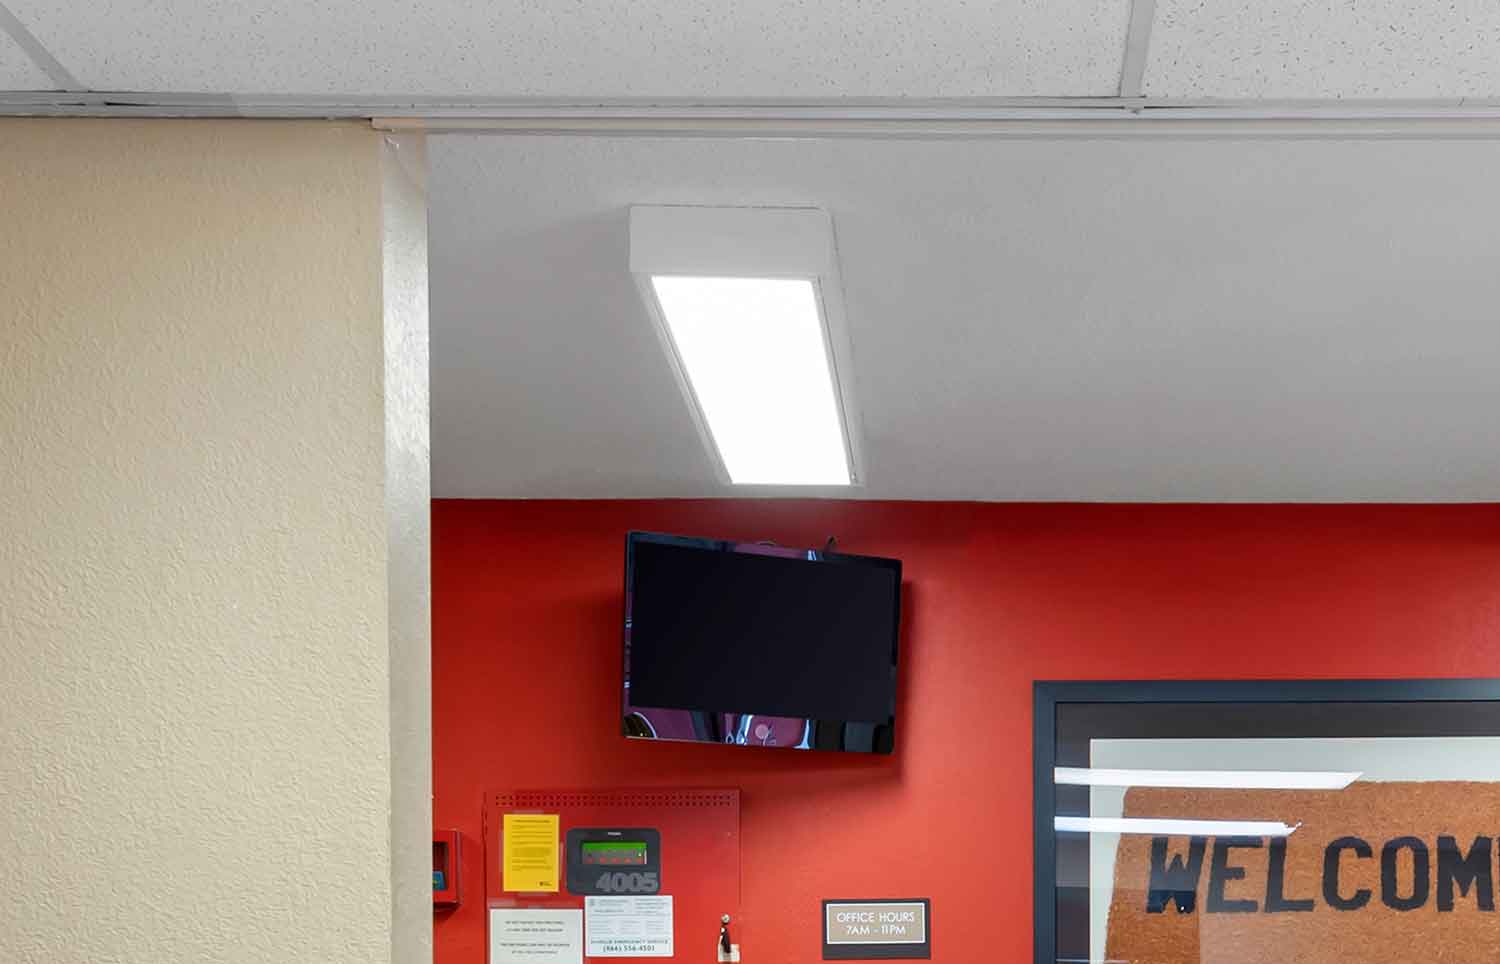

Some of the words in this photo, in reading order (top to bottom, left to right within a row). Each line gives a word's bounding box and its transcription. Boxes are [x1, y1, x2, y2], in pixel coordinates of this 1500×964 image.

[596, 872, 657, 892] 4005
[836, 911, 875, 923] OFFICE
[879, 911, 915, 923] HOURS
[846, 925, 870, 935] 7AM
[881, 924, 906, 935] 11PM
